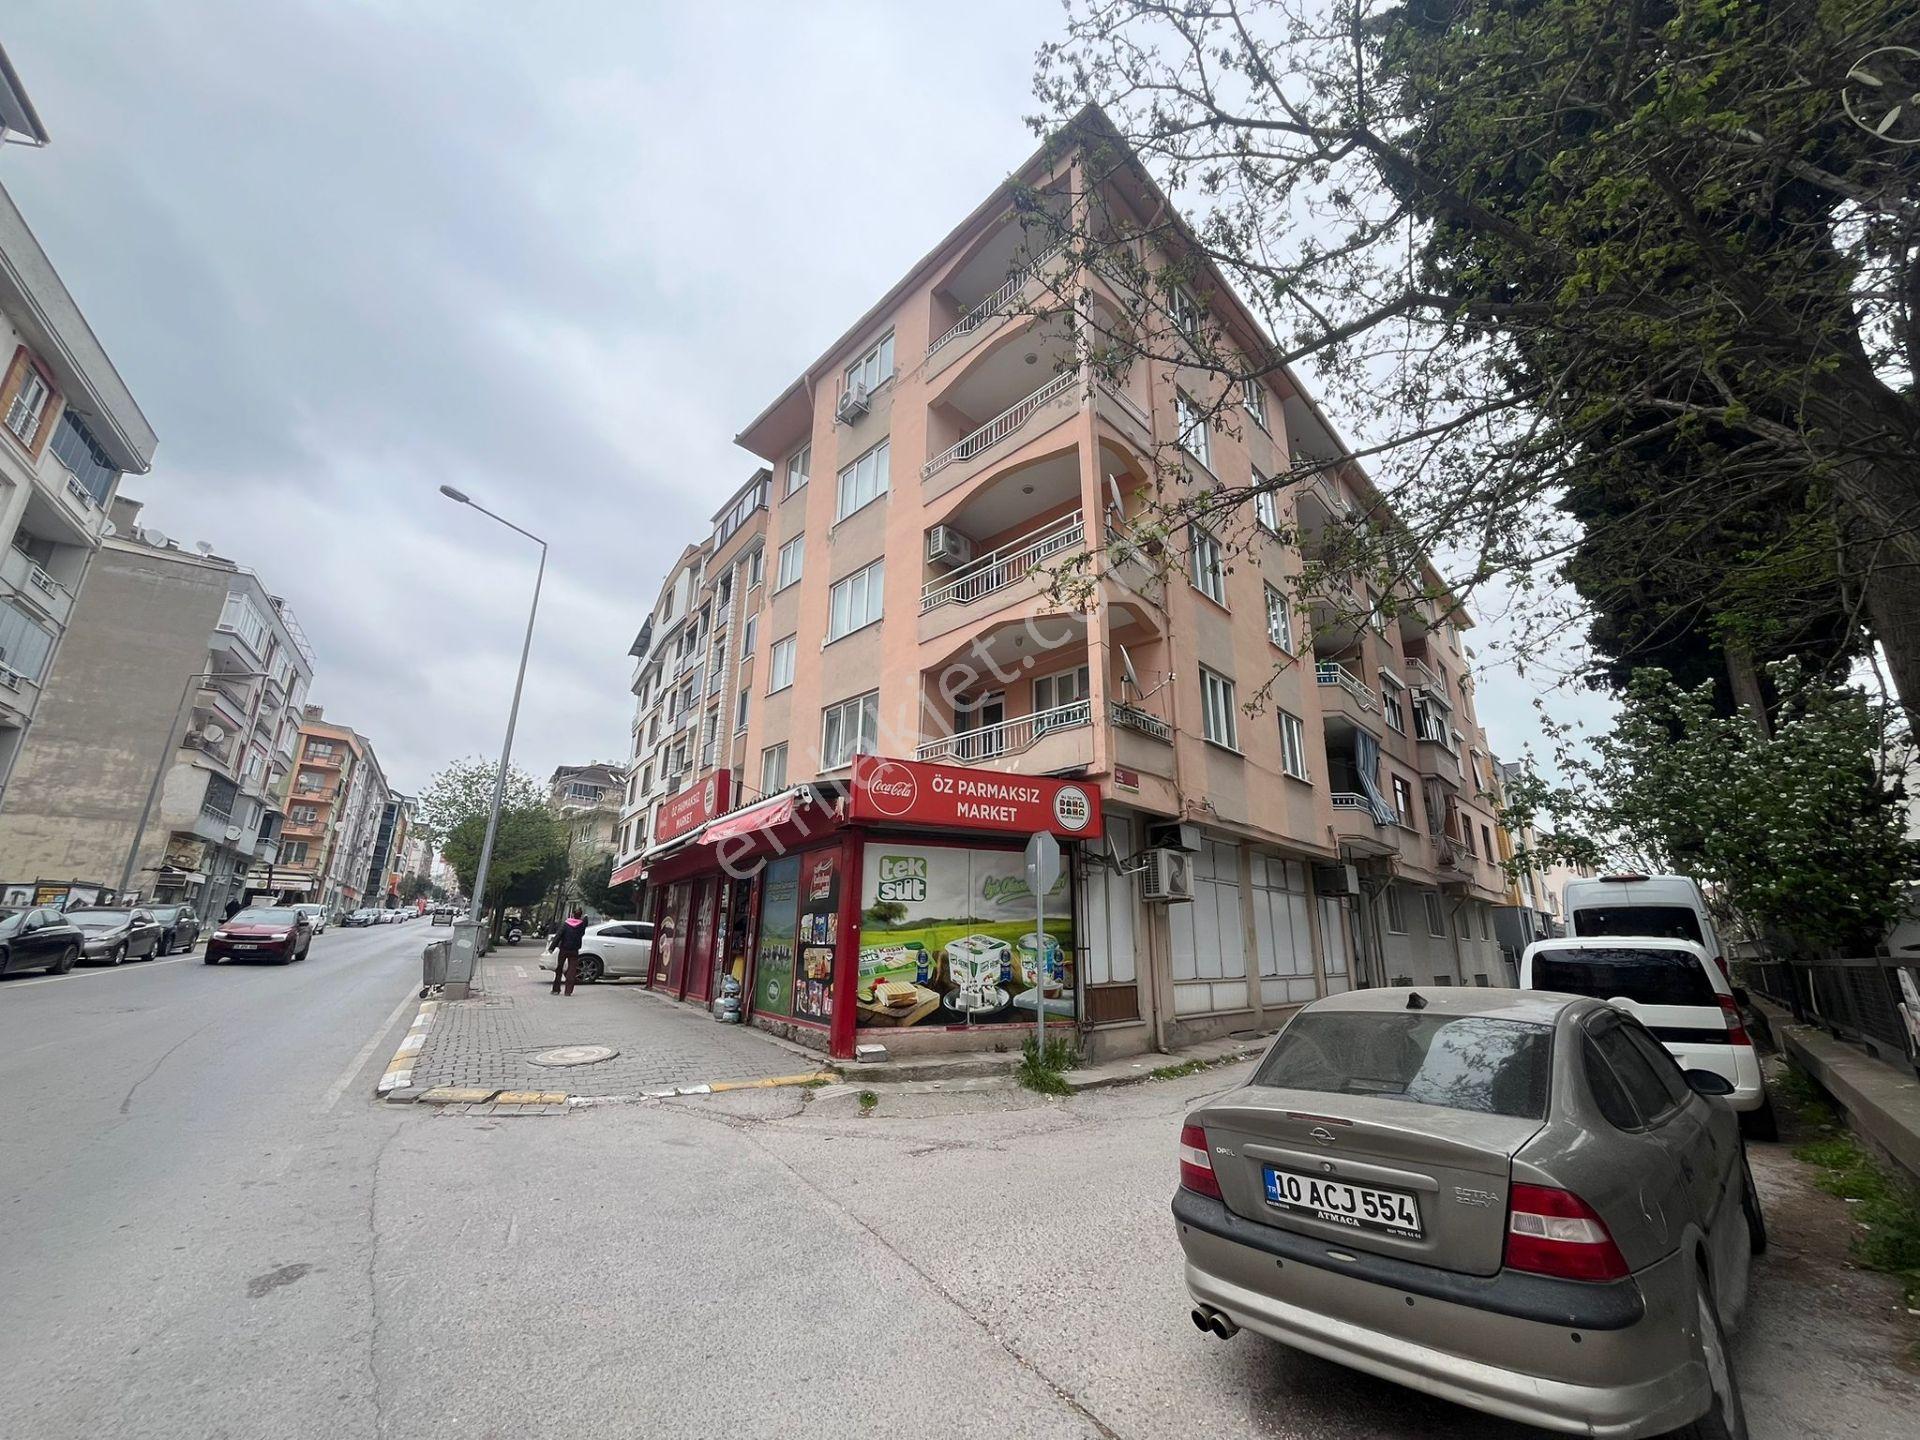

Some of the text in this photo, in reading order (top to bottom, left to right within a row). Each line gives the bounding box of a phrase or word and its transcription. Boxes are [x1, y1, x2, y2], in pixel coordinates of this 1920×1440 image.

[932, 774, 1040, 803] ÖZ PARMAKSIZ
[957, 802, 1017, 822] MARKET
[881, 857, 925, 880] tek
[881, 880, 926, 901] süt
[1267, 1174, 1414, 1226] TR 10 ACJ 554
[1317, 1211, 1360, 1227] ATMACA
